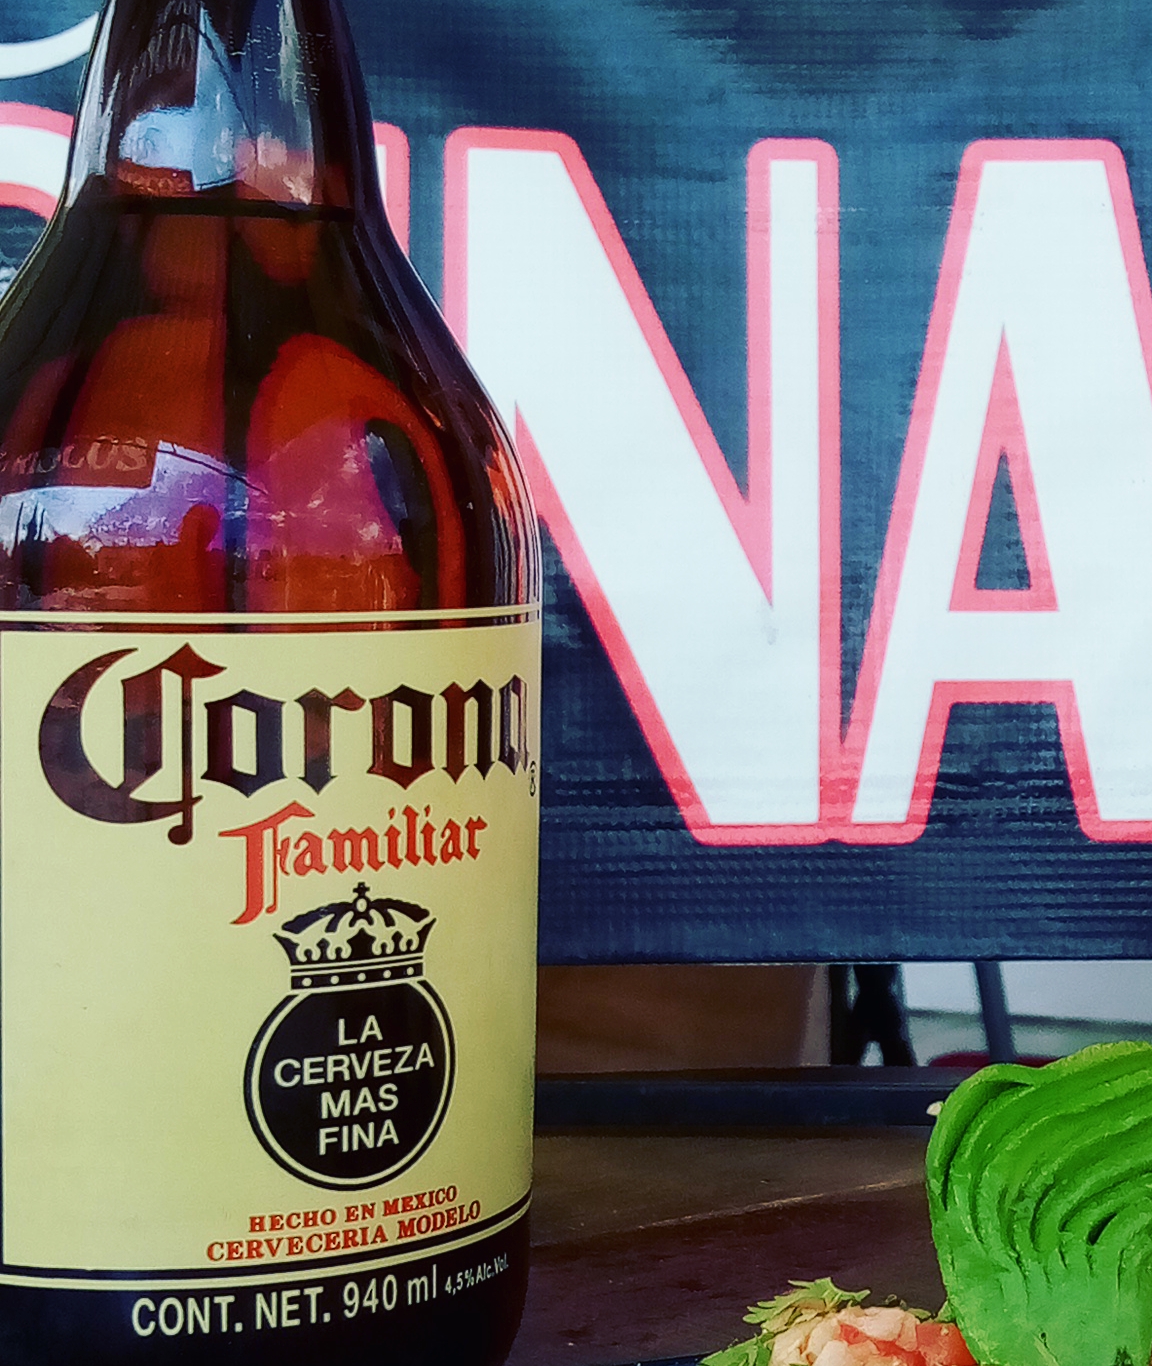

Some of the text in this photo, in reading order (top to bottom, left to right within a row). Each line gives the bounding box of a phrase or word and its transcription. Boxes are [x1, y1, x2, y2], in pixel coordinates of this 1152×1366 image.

[38, 642, 530, 846] Corona
[218, 800, 488, 925] Familiar
[338, 1015, 383, 1046] LA
[274, 1042, 435, 1088] CERVEZA
[321, 1083, 399, 1119] MAS
[319, 1119, 400, 1156] FINA
[206, 1199, 482, 1263] CERVECERIA MODELO
[248, 1185, 458, 1234] HECHO EN MEXICO
[131, 1295, 244, 1337] CONT.
[255, 1286, 332, 1331] NET.
[343, 1274, 398, 1319] 940
[407, 1264, 438, 1306] ml
